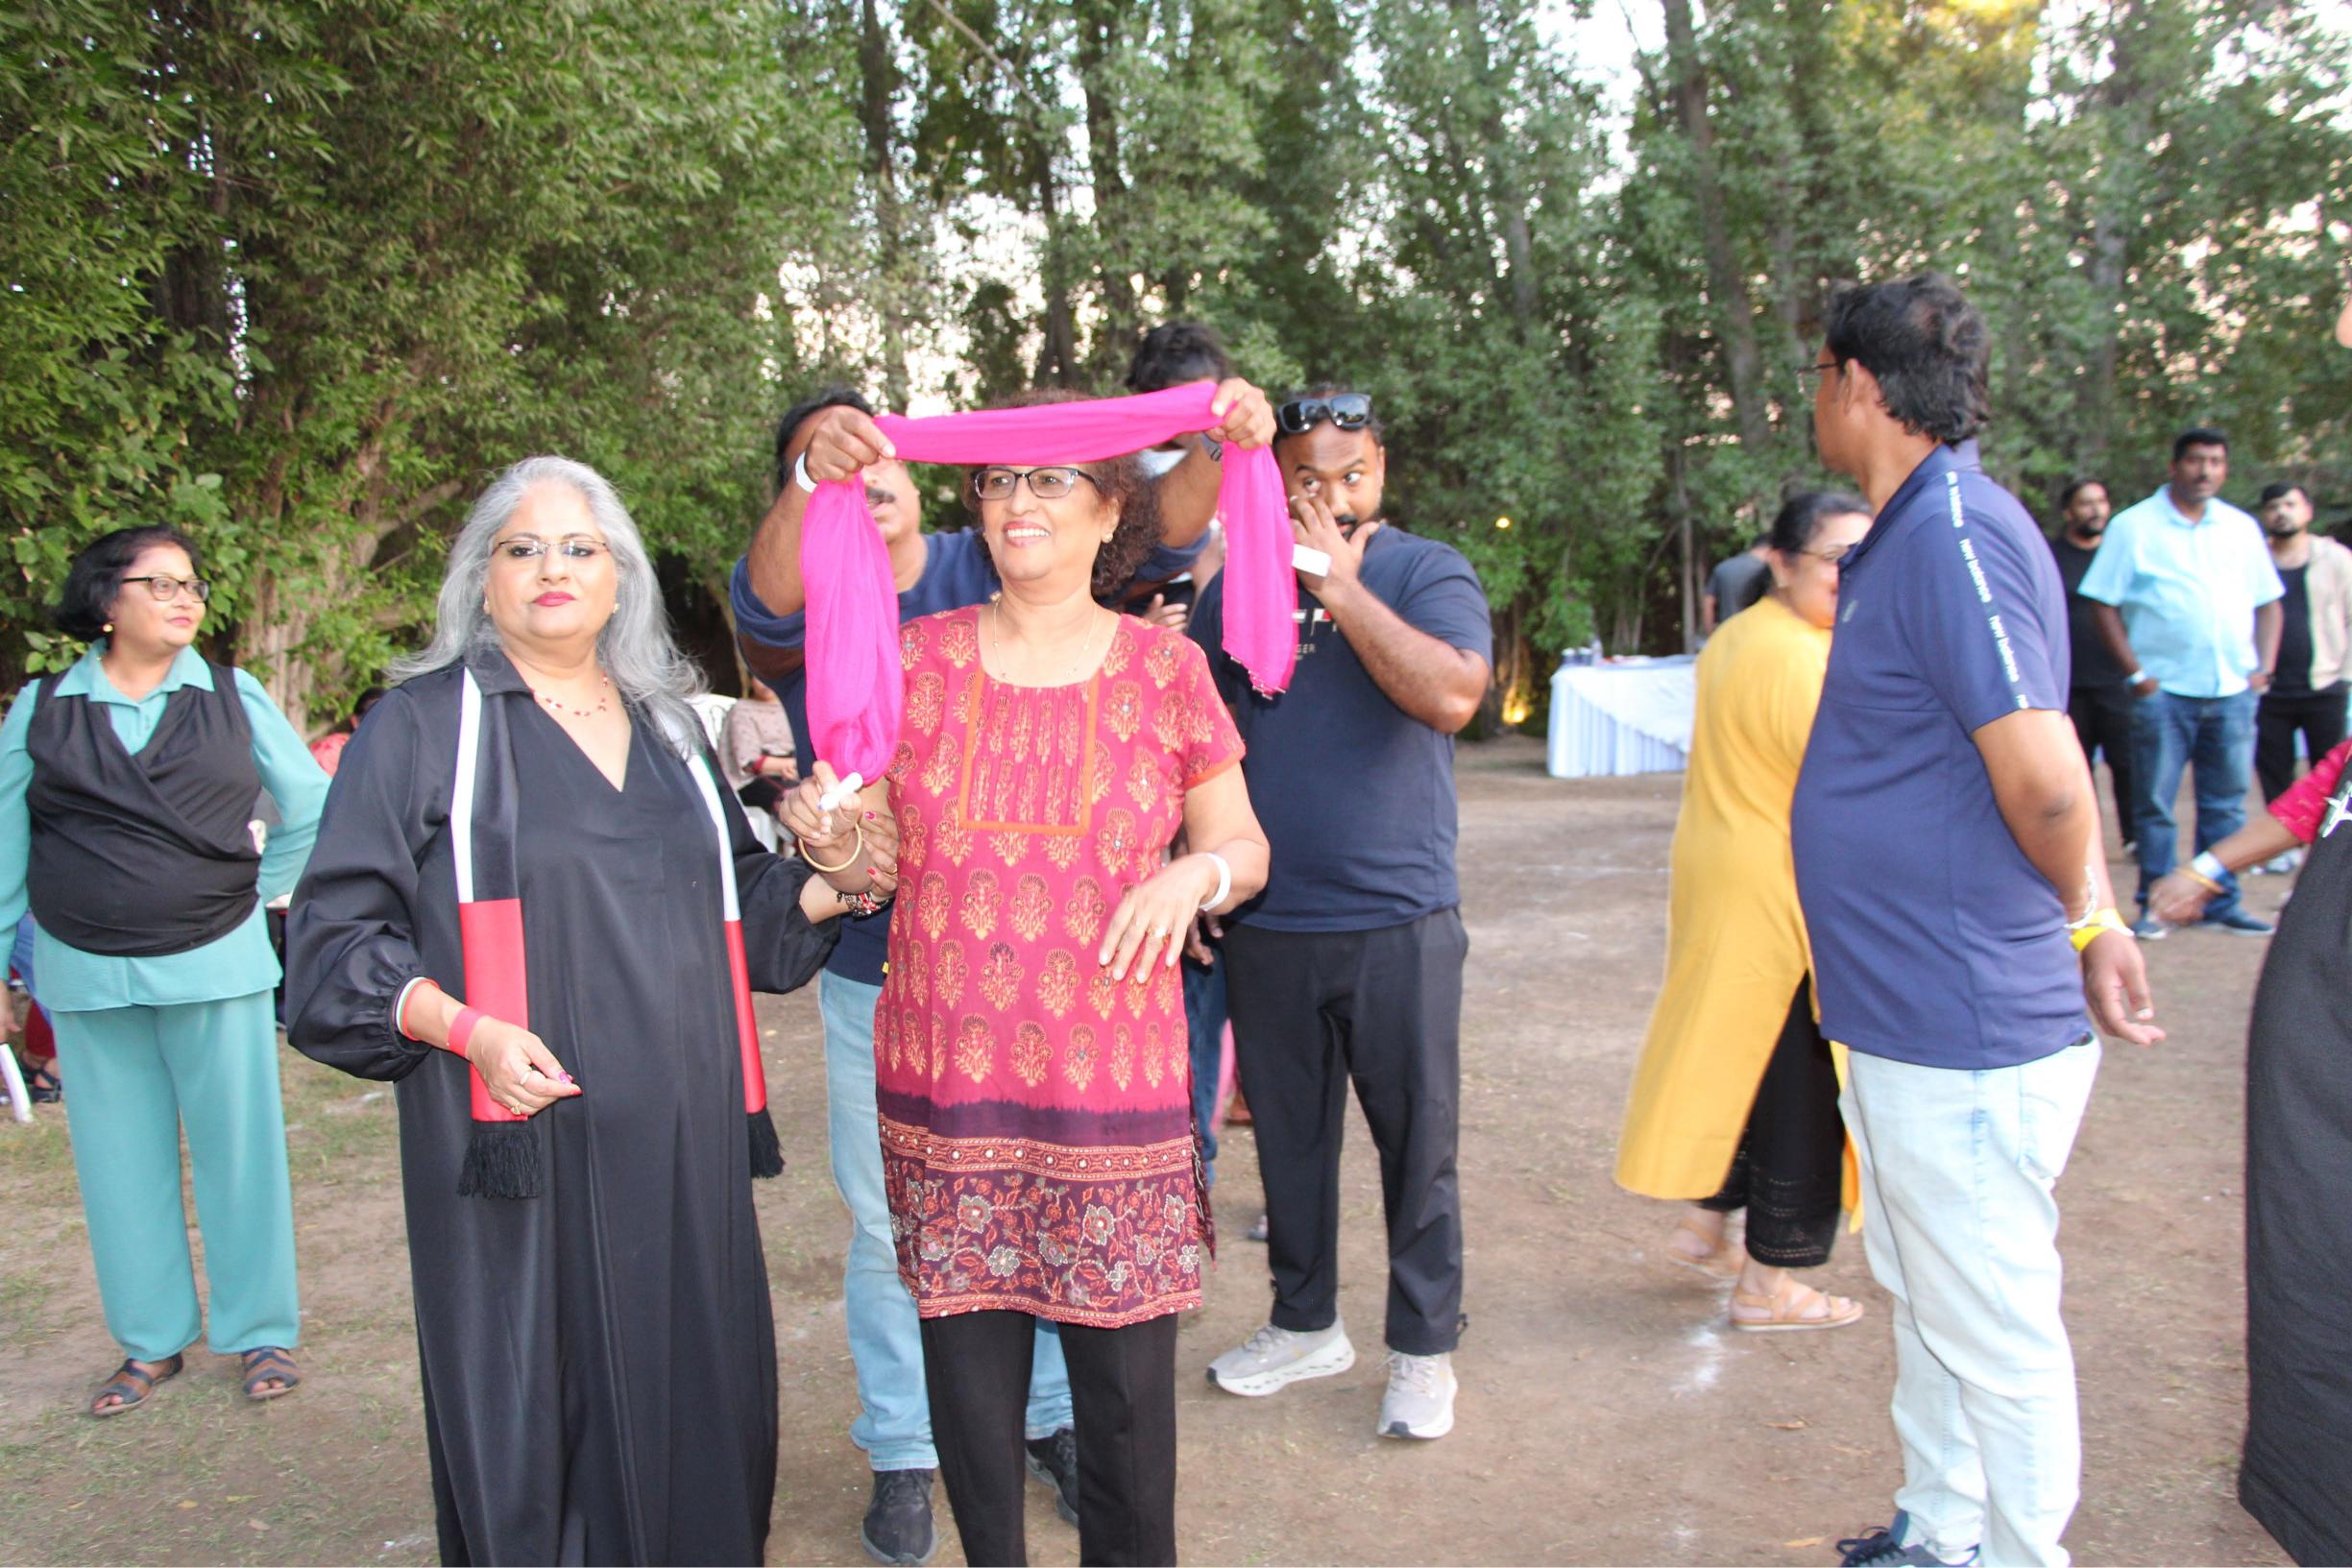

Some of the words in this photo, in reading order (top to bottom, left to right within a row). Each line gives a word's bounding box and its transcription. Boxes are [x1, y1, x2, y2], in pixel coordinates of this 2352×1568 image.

[1959, 539, 1976, 560] new
[1966, 559, 1992, 603] balance
[1988, 615, 2005, 638] new
[1998, 637, 2020, 683] balance
